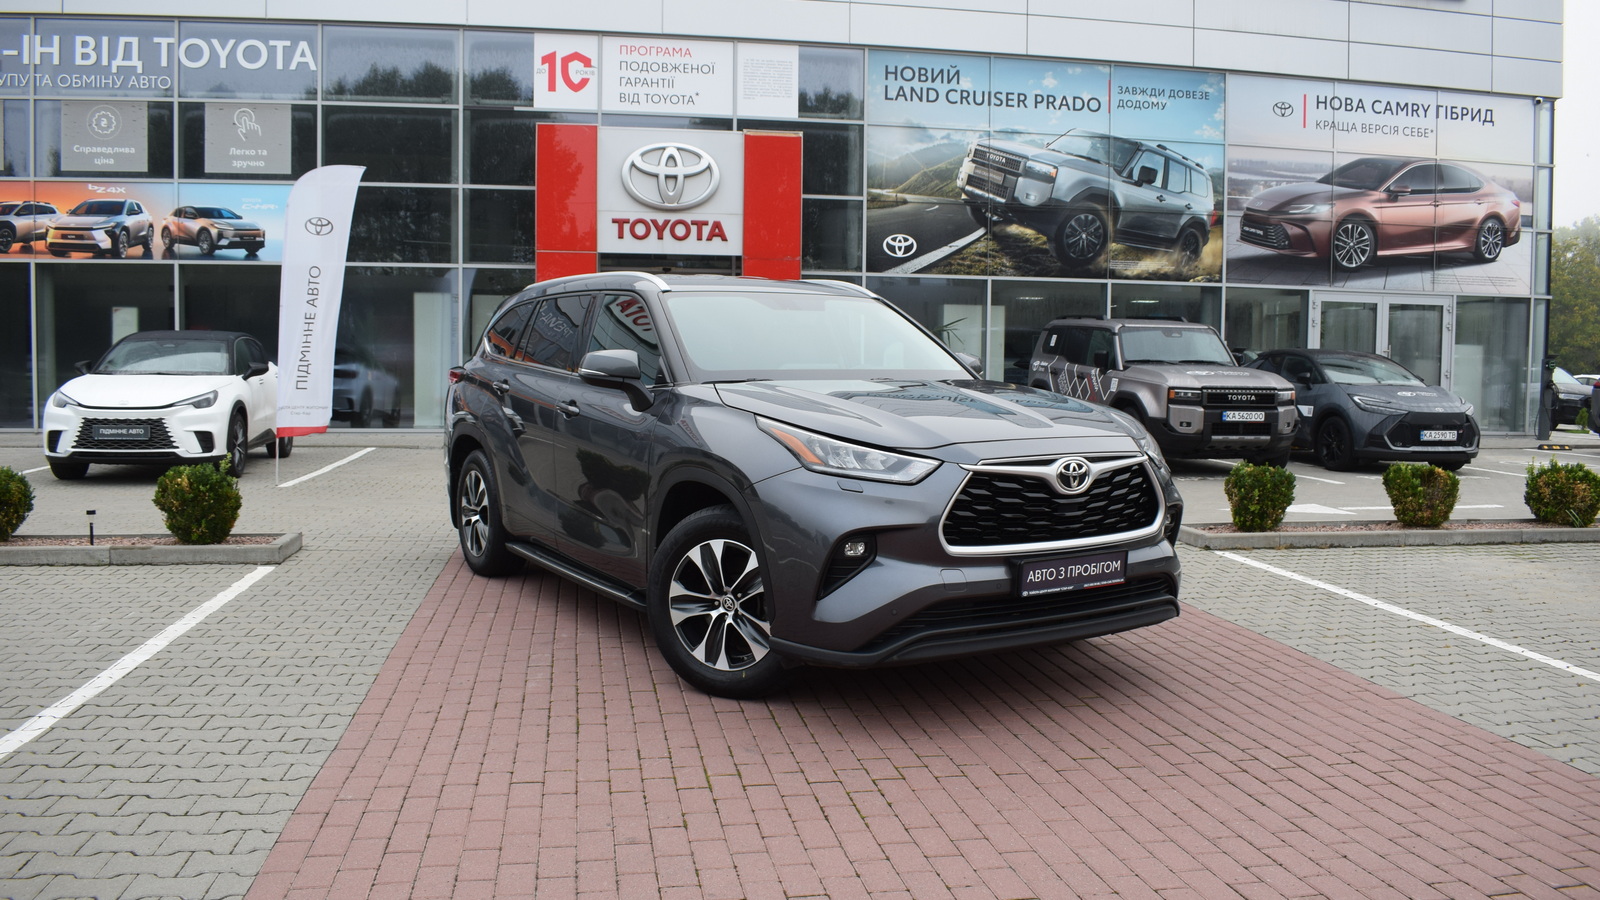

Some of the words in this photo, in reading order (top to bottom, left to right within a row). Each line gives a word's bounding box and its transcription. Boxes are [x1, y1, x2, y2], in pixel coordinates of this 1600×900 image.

[75, 36, 143, 74] ВІД
[153, 37, 318, 71] TOYOTA
[619, 44, 692, 58] ПРОГРАМА
[619, 59, 716, 76] ПОДОВЖЕНОЇ
[884, 64, 961, 86] НОВИЙ
[34, 73, 53, 87] ТА
[57, 74, 124, 88] ОБМІНУ
[128, 75, 172, 89] АВТО
[619, 75, 675, 89] ГАРАНТІЇ
[619, 92, 641, 105] ВІД
[884, 85, 940, 104] LAND
[945, 89, 1028, 109] CRUISER
[1034, 95, 1102, 113] PRADO
[1117, 85, 1166, 98] ЗАВЖДИ
[1168, 89, 1211, 101] ДОВЕЗЕ
[1116, 99, 1168, 111] ДОДОМУ
[1316, 94, 1366, 114] НОВА
[1371, 99, 1431, 119] CAMRY
[1435, 104, 1495, 127] ГІБРИД
[1315, 119, 1358, 133] КРАЩА
[1361, 122, 1400, 136] ВЕРСІЯ
[73, 144, 136, 155] Справедлива
[229, 147, 256, 156] Легко
[94, 156, 115, 165] ціна
[232, 160, 265, 169] зручно
[986, 152, 1007, 164] TOYOTA
[611, 217, 728, 242] TOYOTA
[295, 312, 317, 391] ПІДМІННЕ
[306, 265, 322, 308] АВТО
[1237, 412, 1254, 420] 5620
[1433, 431, 1448, 439] 2590
[1027, 568, 1056, 583] АВТО
[1067, 560, 1121, 578] ПРОБІГОМ
